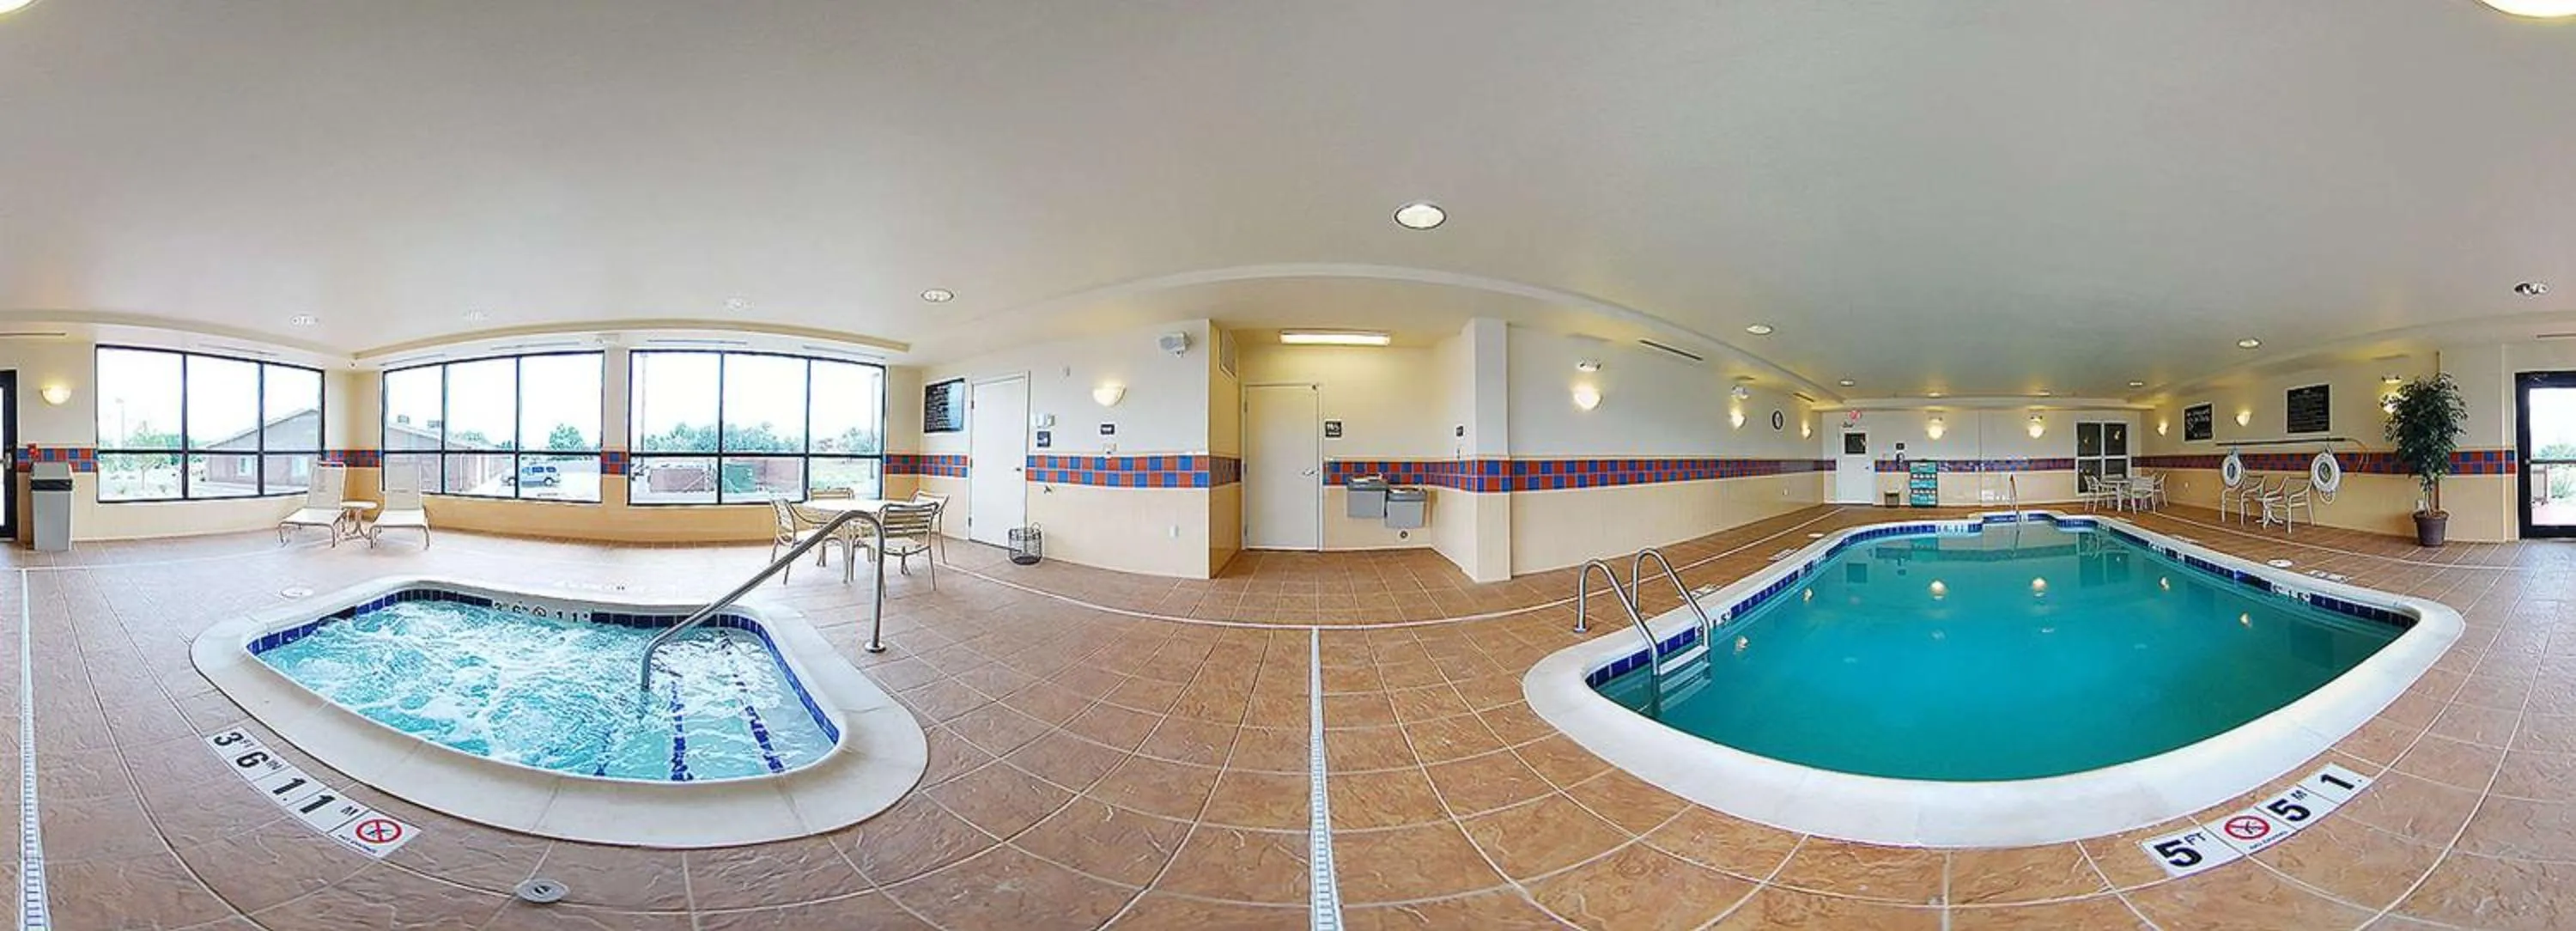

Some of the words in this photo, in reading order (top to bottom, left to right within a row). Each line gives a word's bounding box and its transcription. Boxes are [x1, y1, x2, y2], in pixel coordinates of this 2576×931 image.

[214, 732, 244, 746] 3
[236, 751, 269, 768] 6
[2267, 799, 2312, 822] 5
[2154, 839, 2202, 867] 5
[2184, 830, 2207, 845] FT
